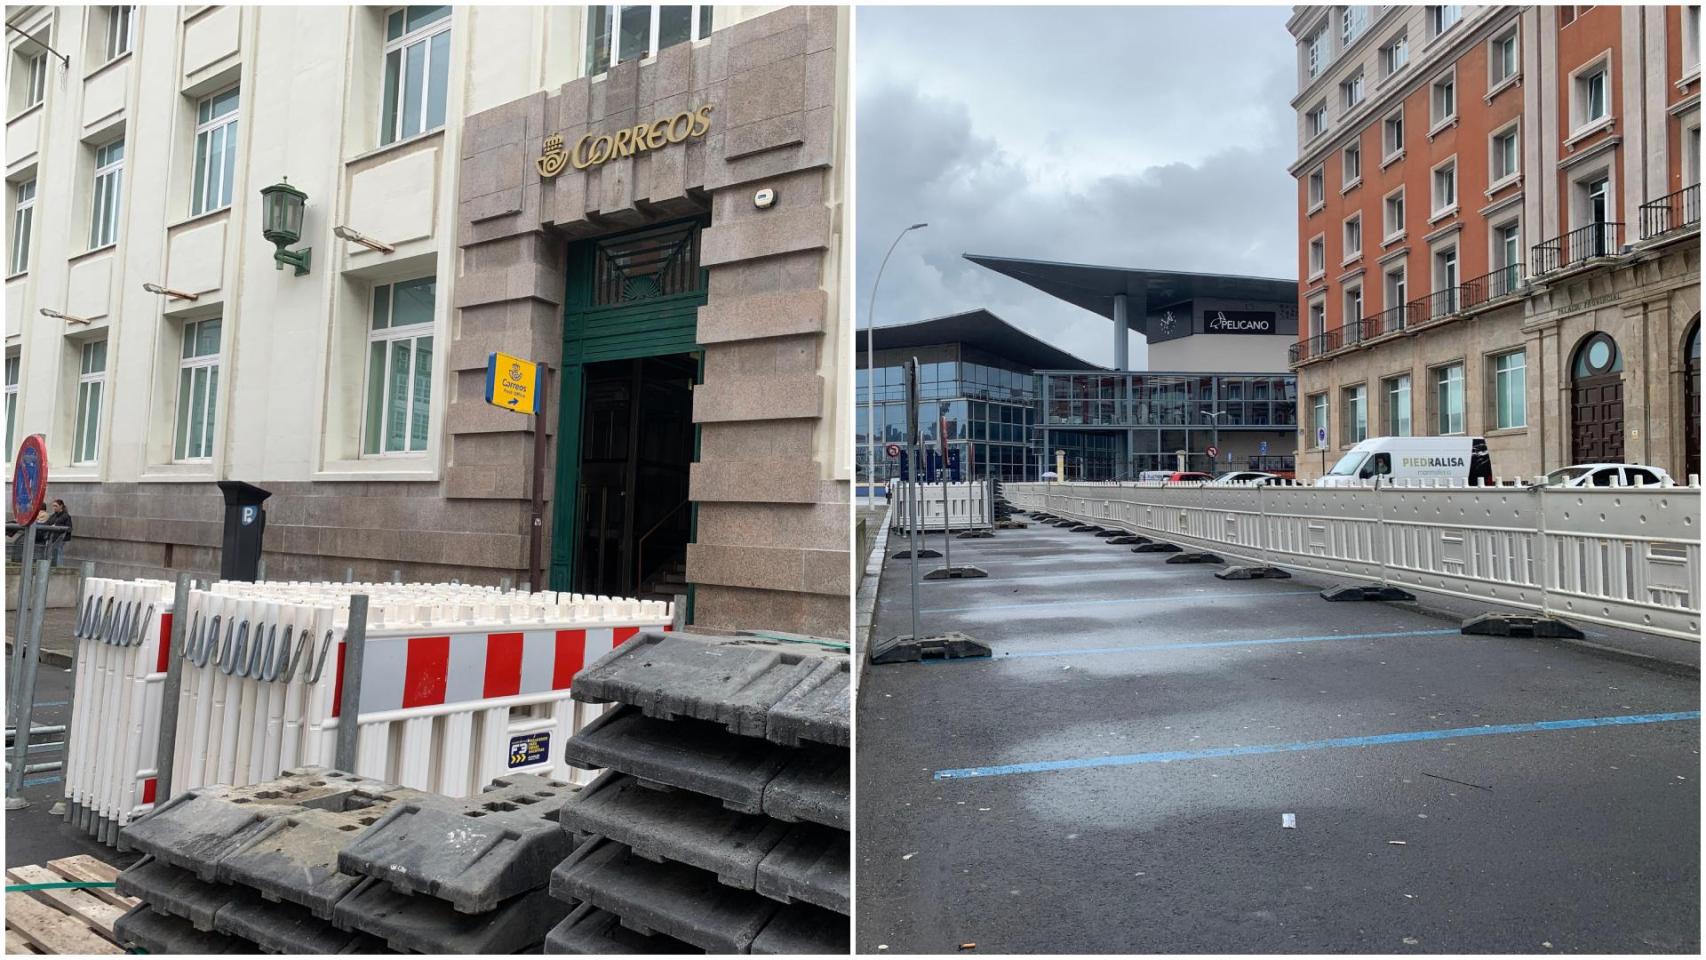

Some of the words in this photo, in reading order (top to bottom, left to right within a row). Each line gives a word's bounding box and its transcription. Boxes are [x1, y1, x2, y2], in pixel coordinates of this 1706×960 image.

[572, 104, 713, 169] CORREOS
[1221, 320, 1269, 330] PELICANO
[502, 378, 527, 393] Correos
[1402, 457, 1465, 467] PIEDRALISA
[511, 742, 528, 755] F3
